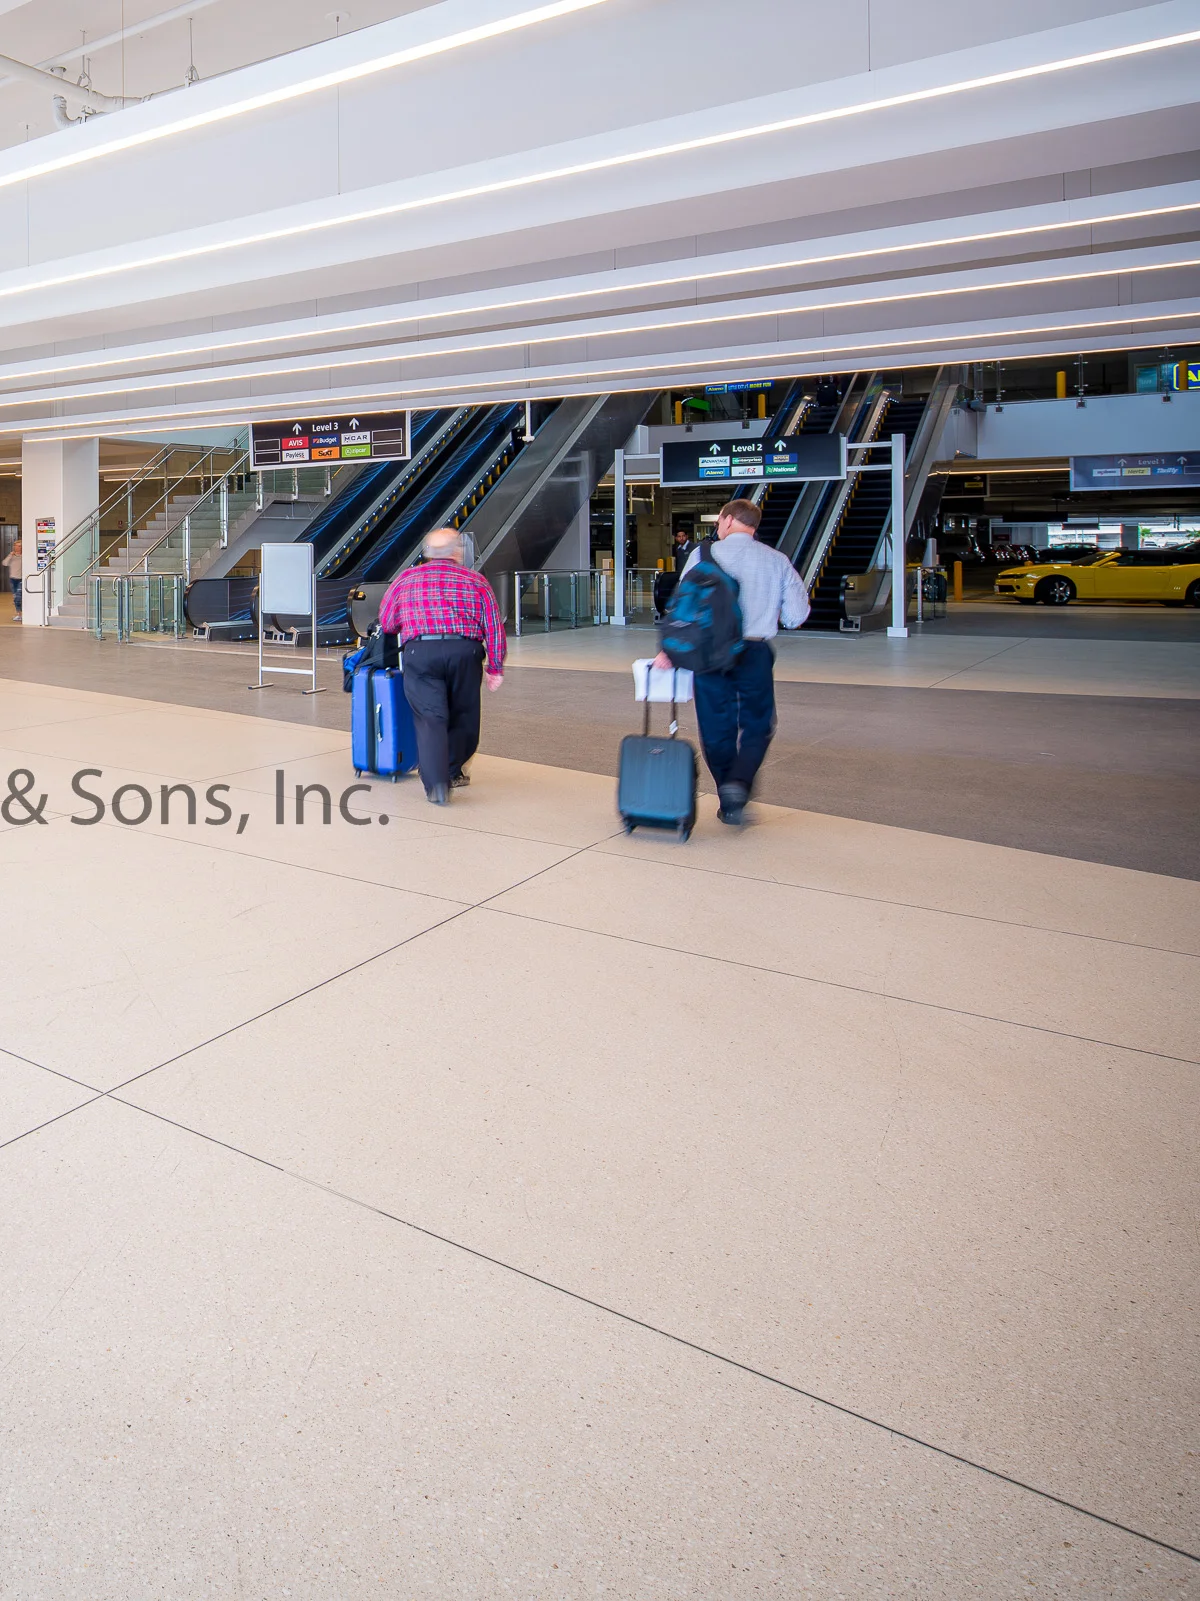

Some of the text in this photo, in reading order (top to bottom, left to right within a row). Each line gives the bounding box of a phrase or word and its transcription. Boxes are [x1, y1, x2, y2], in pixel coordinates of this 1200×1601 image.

[312, 422, 339, 432] Level 3
[288, 439, 304, 447] AVIS
[319, 437, 337, 445] Budget
[732, 443, 763, 452] Level 2
